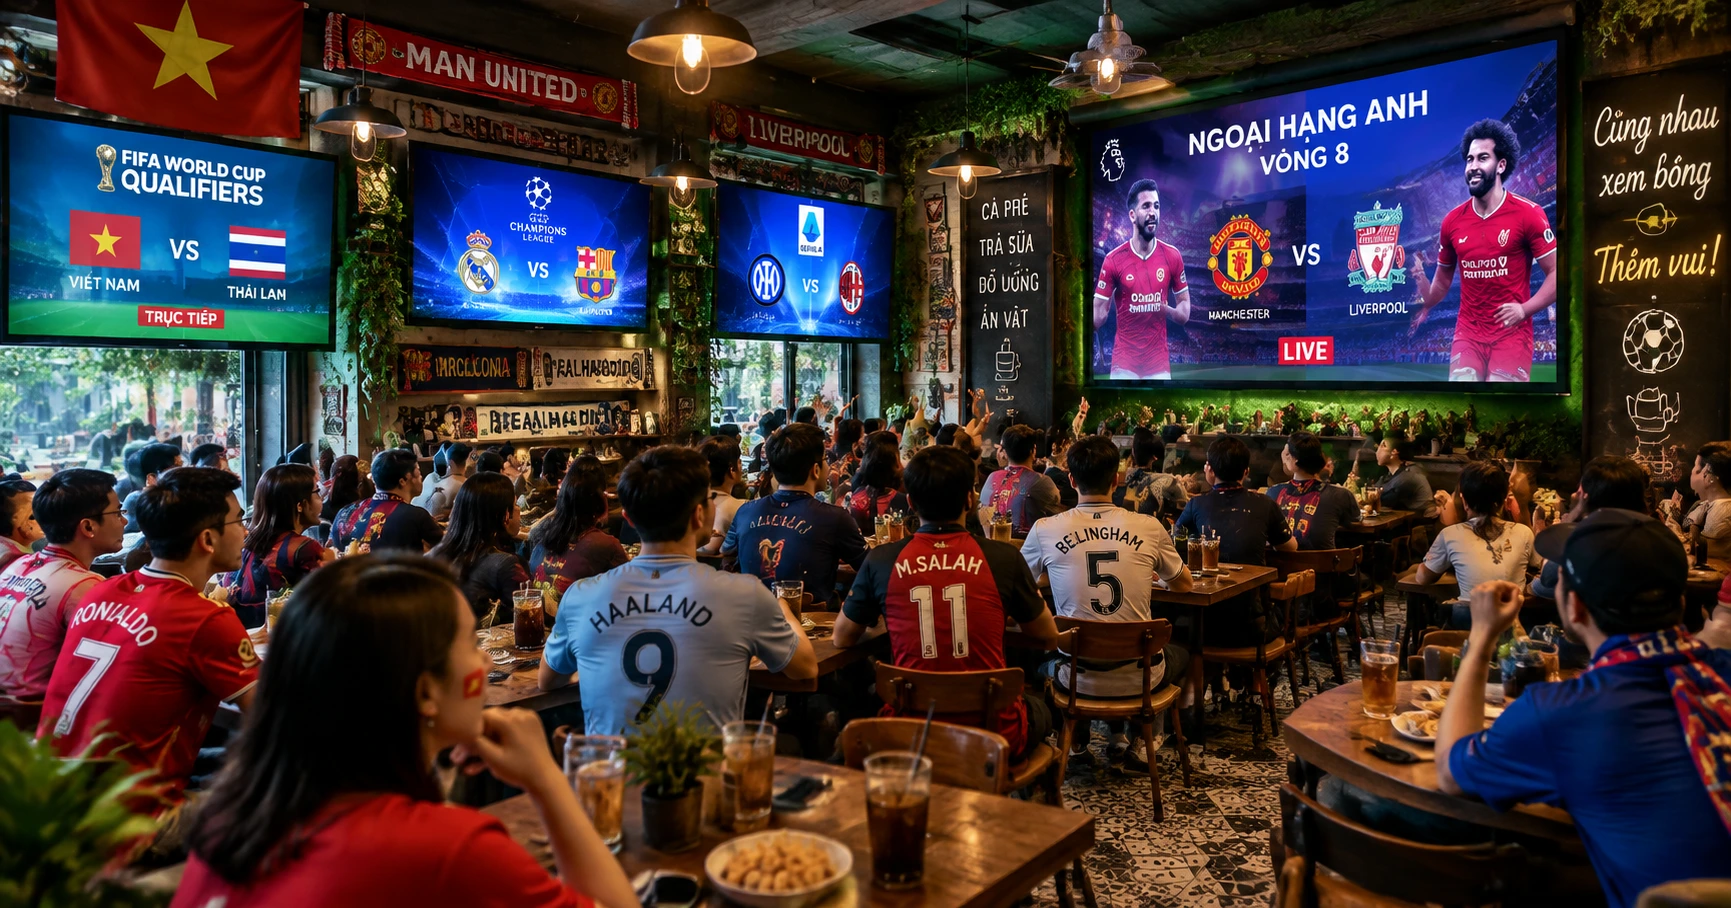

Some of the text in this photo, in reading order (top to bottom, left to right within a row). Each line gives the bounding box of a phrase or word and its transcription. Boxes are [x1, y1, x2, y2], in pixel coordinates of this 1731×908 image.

[406, 42, 475, 82] MAN
[484, 60, 578, 103] UNITED
[1188, 89, 1428, 155] NGOẠI HẠNG ANH
[1659, 93, 1720, 136] nhau
[121, 149, 267, 184] FIFA WORLD CUP
[1335, 142, 1349, 165] 8
[121, 168, 264, 206] QUALIFIERS
[1599, 170, 1647, 197] xem
[509, 221, 568, 237] CHAMPIONS
[170, 238, 200, 261] VS
[1292, 243, 1321, 267] VS
[527, 261, 549, 279] VS
[105, 277, 140, 293] NAM
[802, 278, 819, 293] VS
[144, 310, 183, 328] TRỤC
[1283, 341, 1328, 361] LIVE
[895, 553, 983, 580] M.SALAH
[1085, 550, 1124, 616] 5
[589, 593, 713, 634] HAALAND
[909, 582, 970, 660] 11
[53, 636, 121, 736] 7
[621, 628, 677, 725] 9
